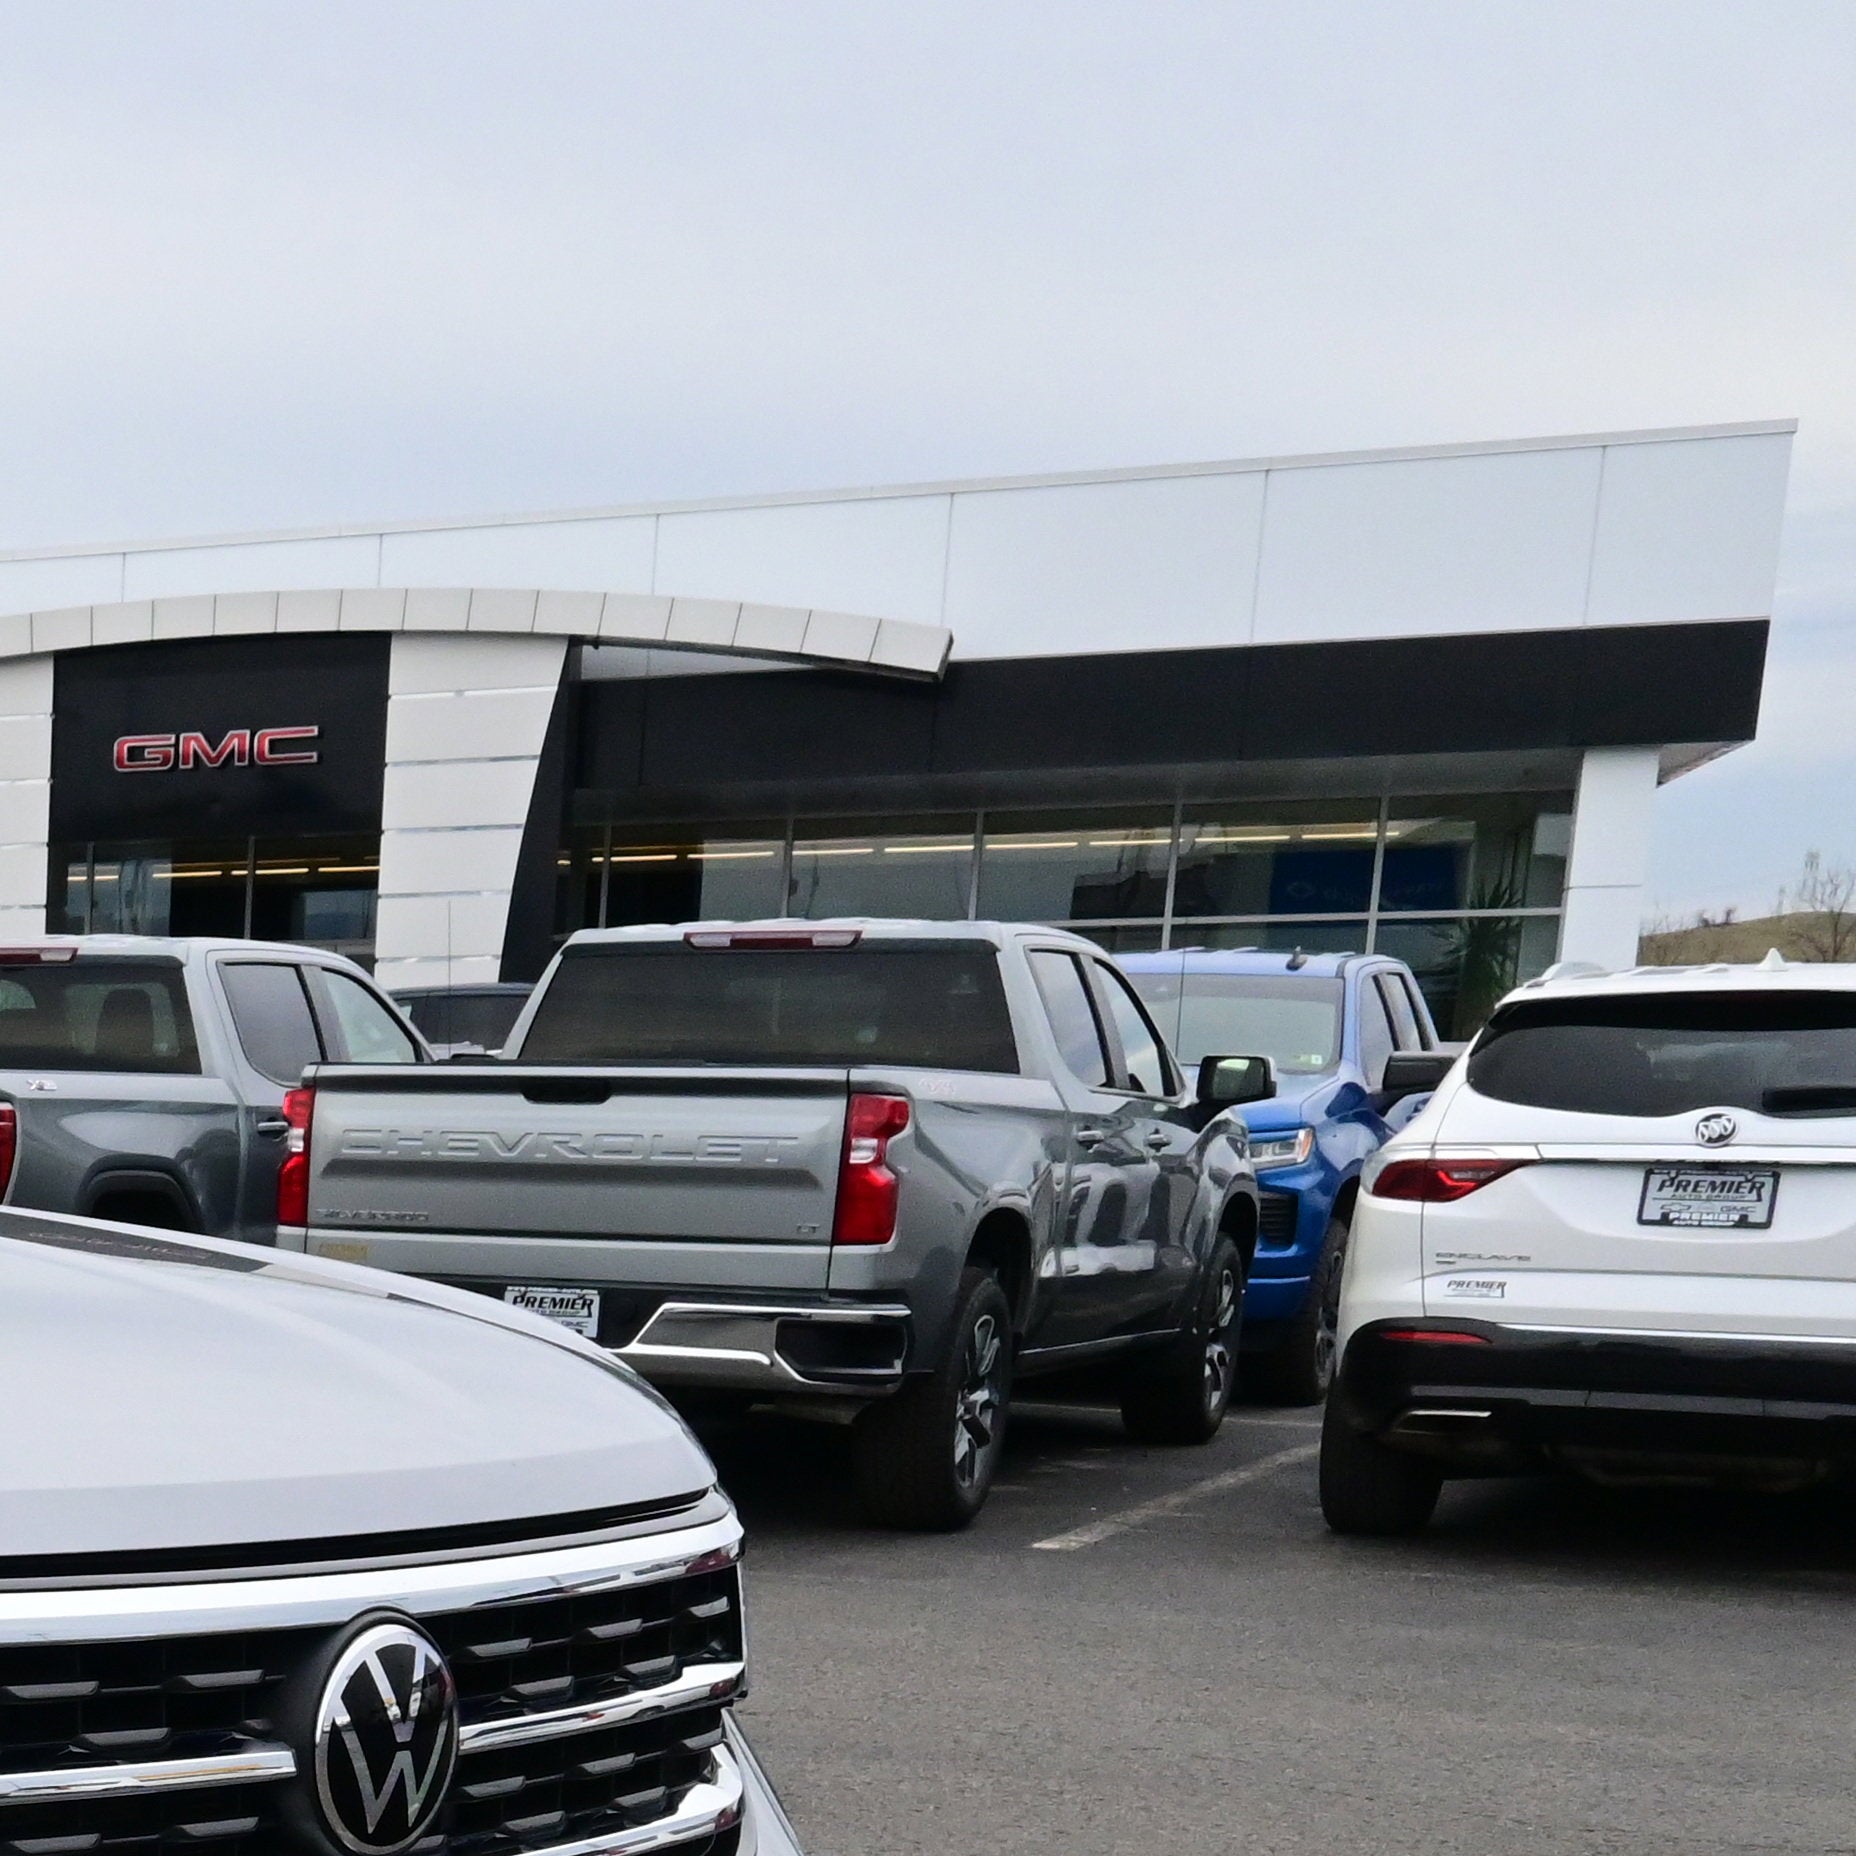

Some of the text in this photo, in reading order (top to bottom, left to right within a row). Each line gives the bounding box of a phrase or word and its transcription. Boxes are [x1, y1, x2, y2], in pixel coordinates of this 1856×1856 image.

[113, 725, 319, 772] GMC
[340, 1128, 800, 1164] CHEVROLET
[1657, 1179, 1765, 1202] PREMIER
[1669, 1212, 1740, 1221] PREMIER
[1447, 1279, 1508, 1298] PREMIER
[512, 1294, 594, 1318] PREMIER
